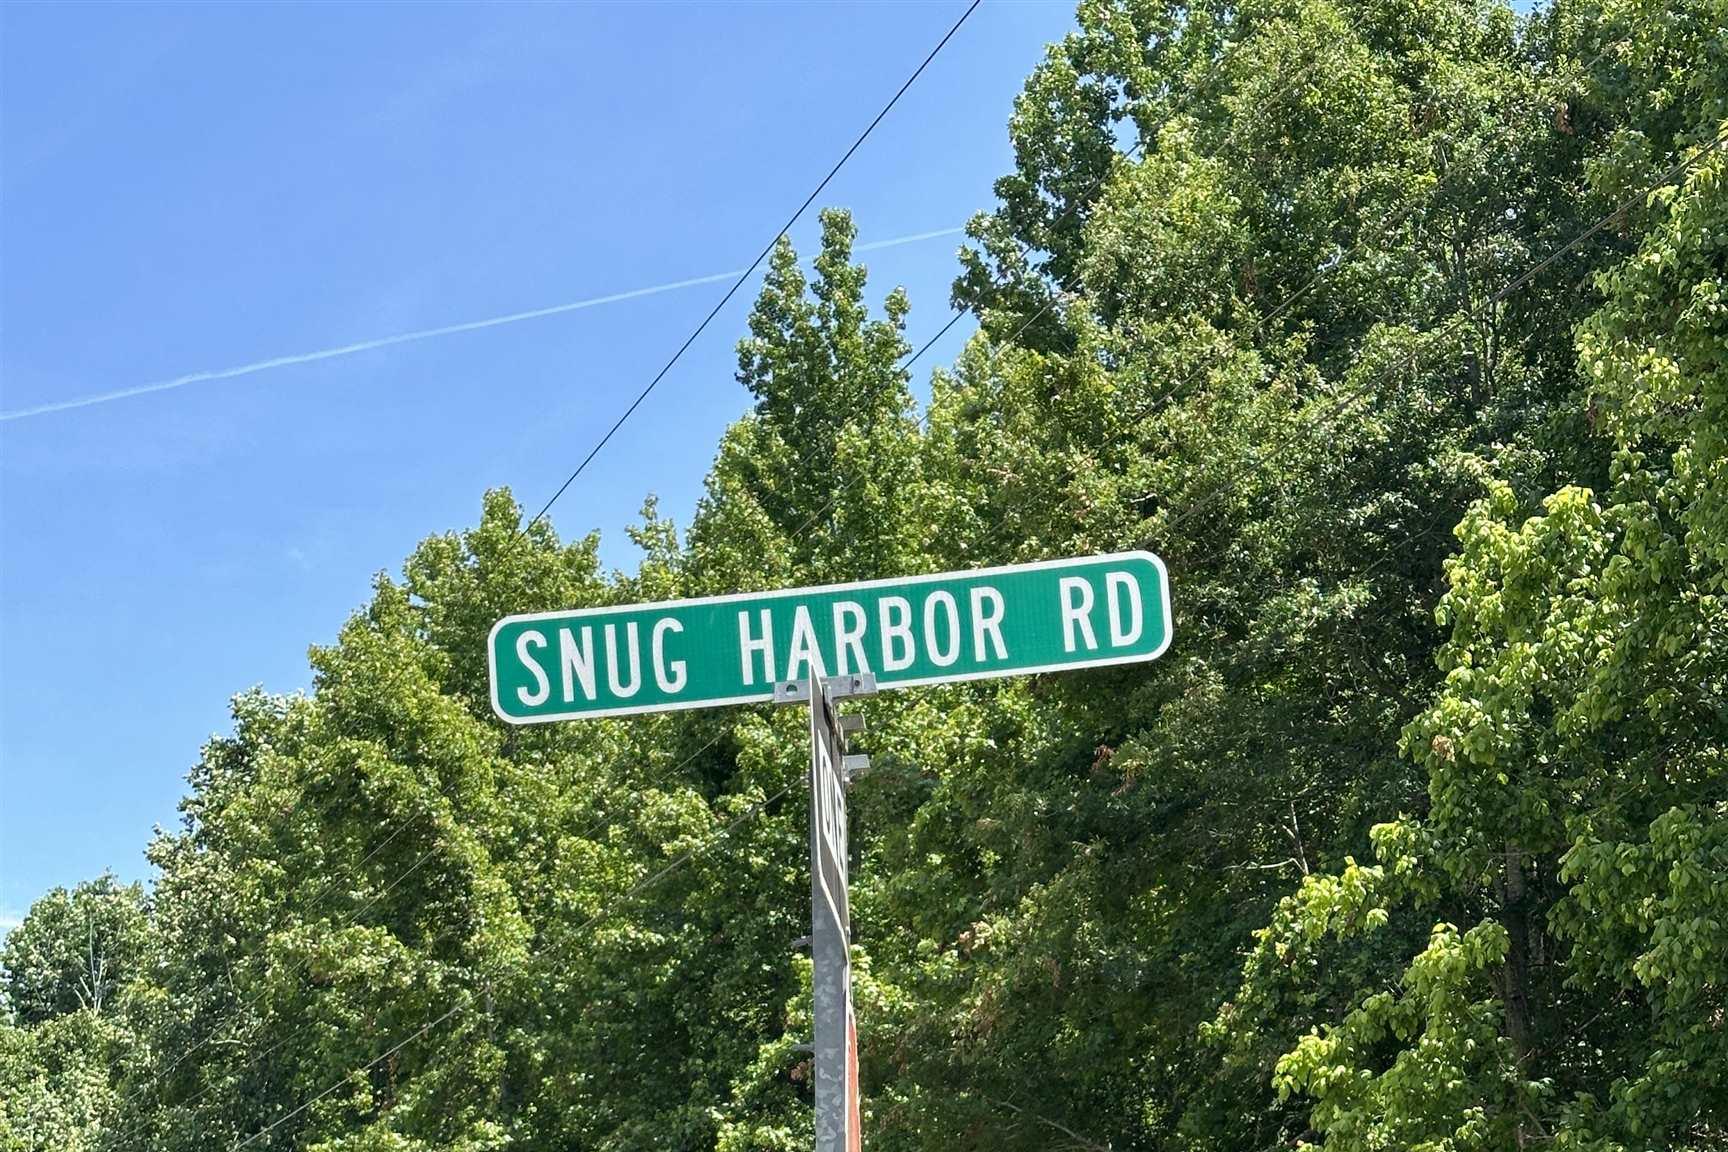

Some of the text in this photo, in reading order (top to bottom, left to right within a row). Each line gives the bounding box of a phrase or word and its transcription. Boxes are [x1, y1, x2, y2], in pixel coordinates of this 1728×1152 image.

[517, 571, 1144, 706] SNUG HARBOR RD
